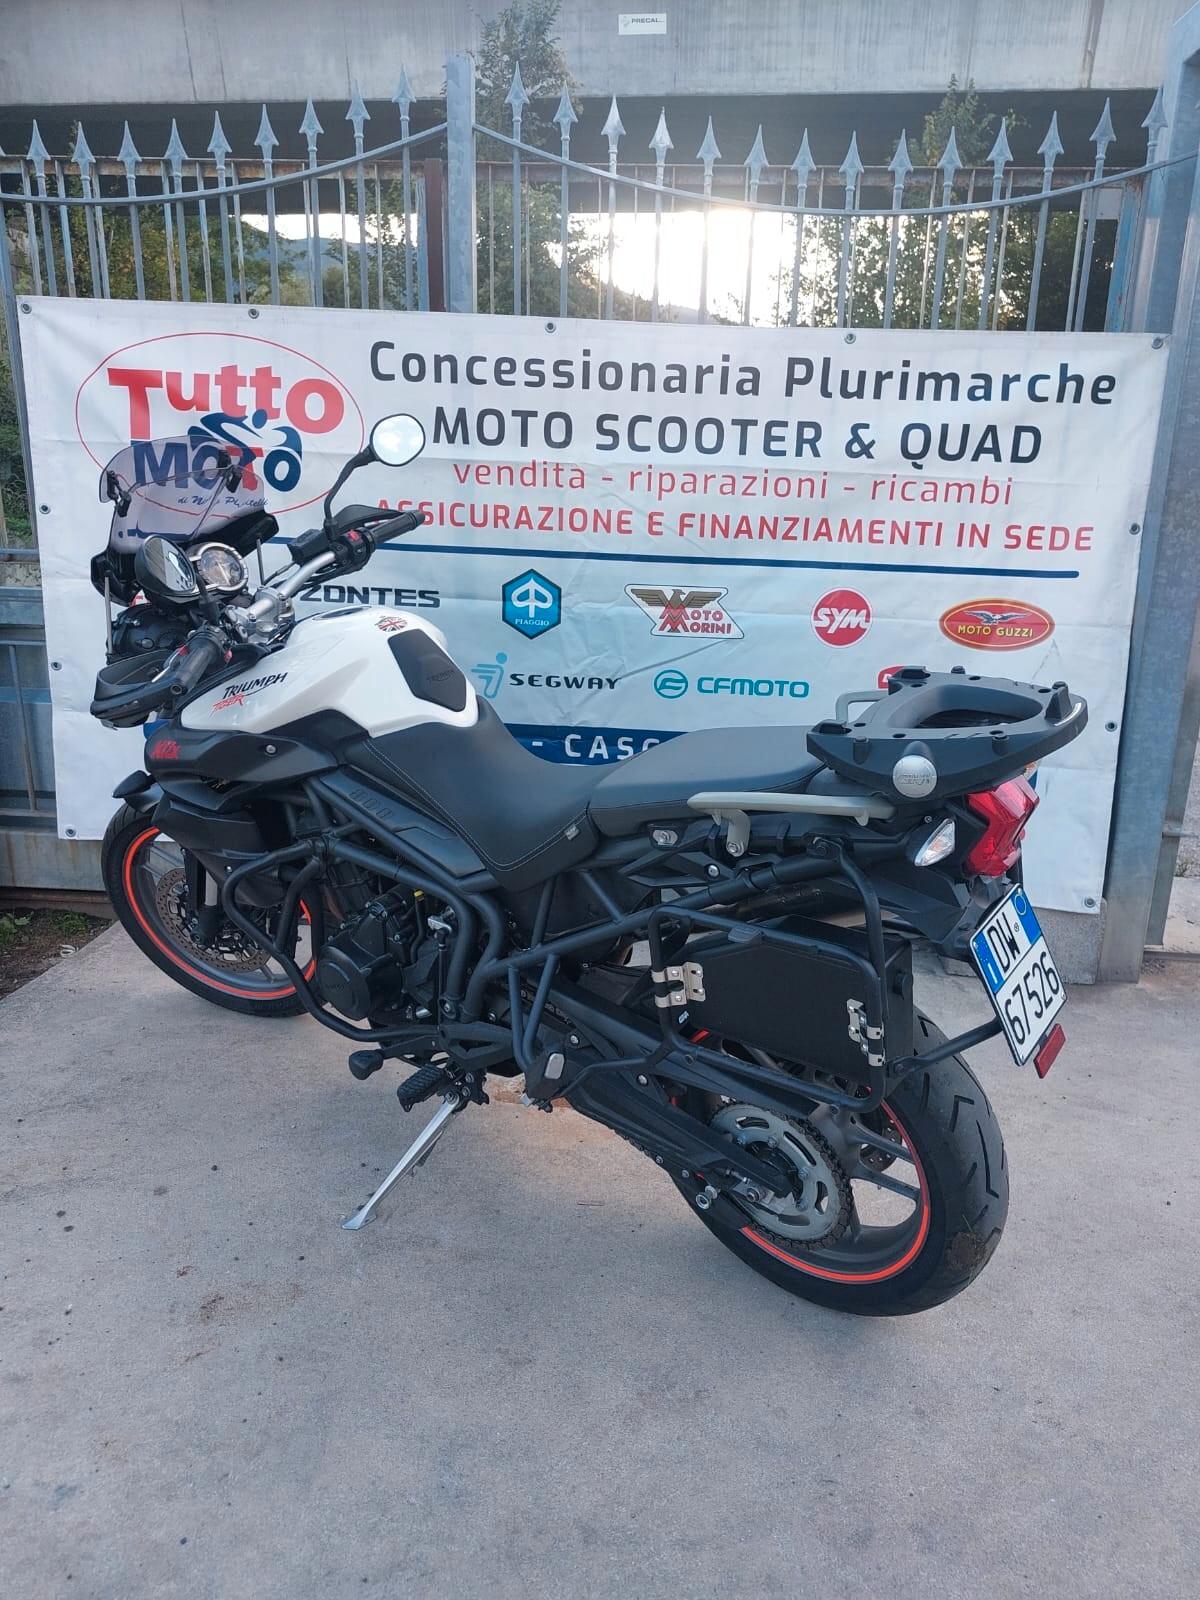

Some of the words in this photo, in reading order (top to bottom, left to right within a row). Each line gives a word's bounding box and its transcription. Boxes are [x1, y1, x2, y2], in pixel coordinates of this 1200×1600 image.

[370, 341, 761, 396] Concessionaria
[785, 357, 1116, 405] Plurimarche
[107, 365, 345, 440] Tutto
[433, 406, 573, 448] MOTO
[596, 413, 822, 458] SCOOTER
[844, 422, 876, 459] &
[900, 423, 1042, 470] QUAD
[453, 459, 586, 489] vendita
[629, 464, 829, 501] riparazioni
[871, 473, 1013, 505] ricambi
[647, 511, 663, 536] E
[679, 512, 943, 547] FINANZIAMENTI
[957, 522, 990, 548] IN
[1004, 524, 1095, 551] SEDE
[300, 584, 440, 608] ZONTES
[515, 618, 550, 626] PIAGGIO
[659, 613, 732, 634] MORINI
[814, 607, 869, 634] SYM
[958, 625, 991, 635] MOTO
[996, 627, 1033, 637] GUZZI
[223, 672, 288, 699] TRIUMPH
[509, 673, 621, 689] SEGWAY
[697, 677, 810, 698] CFMOTO
[987, 912, 1020, 972] DW
[1005, 951, 1060, 1045] 67526
